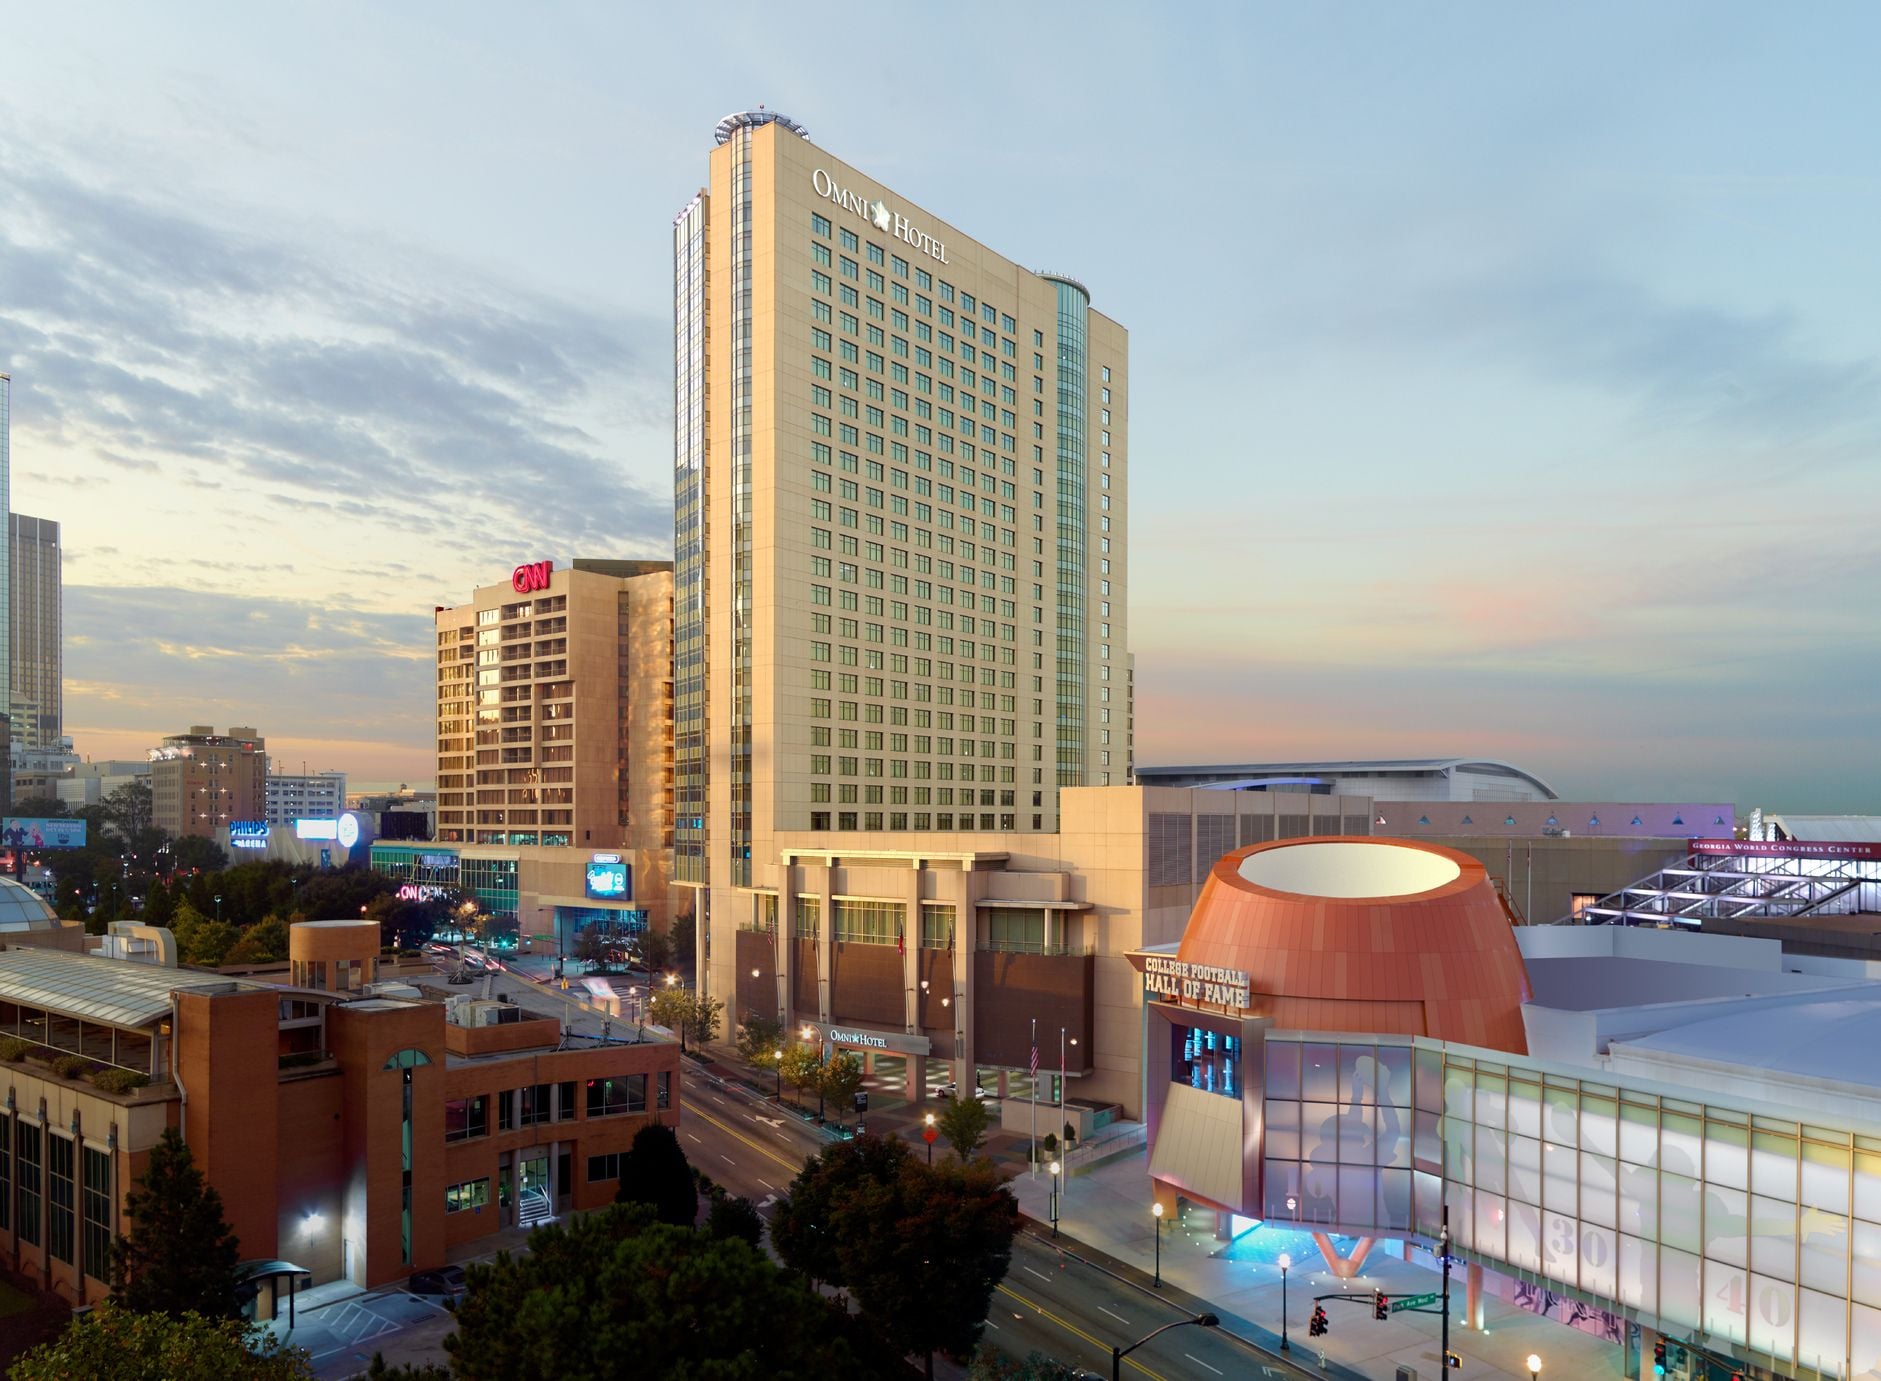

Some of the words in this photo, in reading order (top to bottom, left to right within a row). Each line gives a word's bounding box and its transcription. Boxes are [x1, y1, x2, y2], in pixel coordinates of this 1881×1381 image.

[812, 168, 870, 221] OMNI
[892, 211, 950, 265] HOTEL
[512, 560, 553, 593] CNN
[229, 820, 270, 836] PHILIPS
[239, 839, 267, 848] ARENA
[1692, 842, 1731, 850] GEORGIA
[1734, 843, 1767, 851] WORLD
[1770, 844, 1824, 853] CONGRESS
[1828, 845, 1871, 854] CENTER
[401, 885, 418, 900] CNN
[1145, 957, 1189, 977] COLLEGE
[1191, 963, 1246, 986] FOOTBALL
[1145, 972, 1179, 996] HALL
[1183, 979, 1201, 1000] OF
[1204, 983, 1247, 1008] FAME
[830, 1029, 852, 1043] OMNI
[859, 1034, 888, 1048] HOTEL
[1551, 1218, 1608, 1268] 30
[1715, 1274, 1792, 1328] 40
